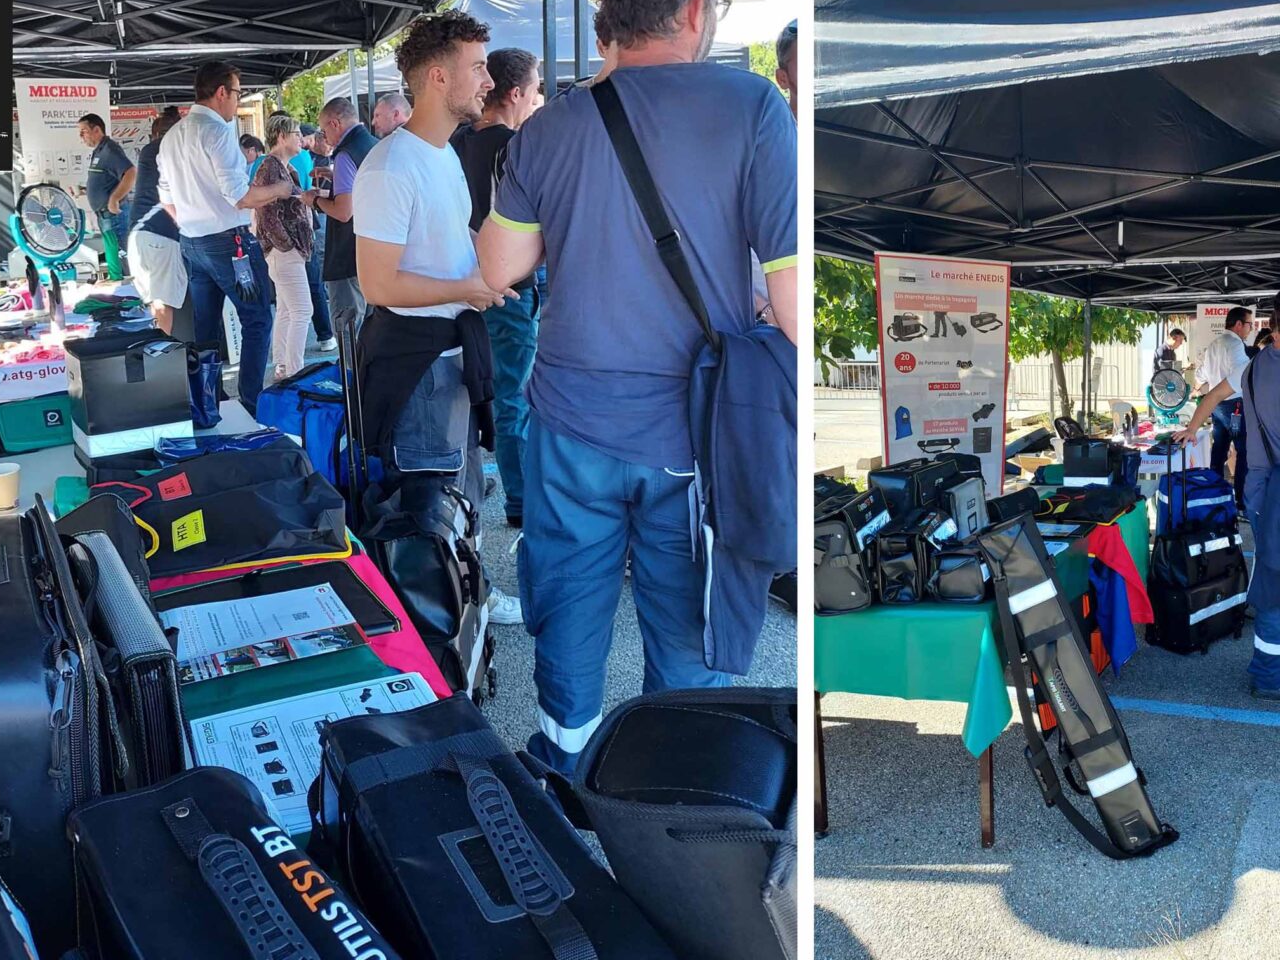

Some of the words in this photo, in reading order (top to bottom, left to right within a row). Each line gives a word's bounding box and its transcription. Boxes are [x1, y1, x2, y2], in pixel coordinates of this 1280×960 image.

[28, 85, 97, 98] MICHAUD
[930, 270, 941, 279] Le
[942, 271, 974, 281] marché
[975, 274, 1005, 283] ENEDIS
[900, 353, 910, 361] 20
[176, 522, 189, 542] HTA
[250, 825, 297, 858] BT
[279, 860, 336, 913] TST
